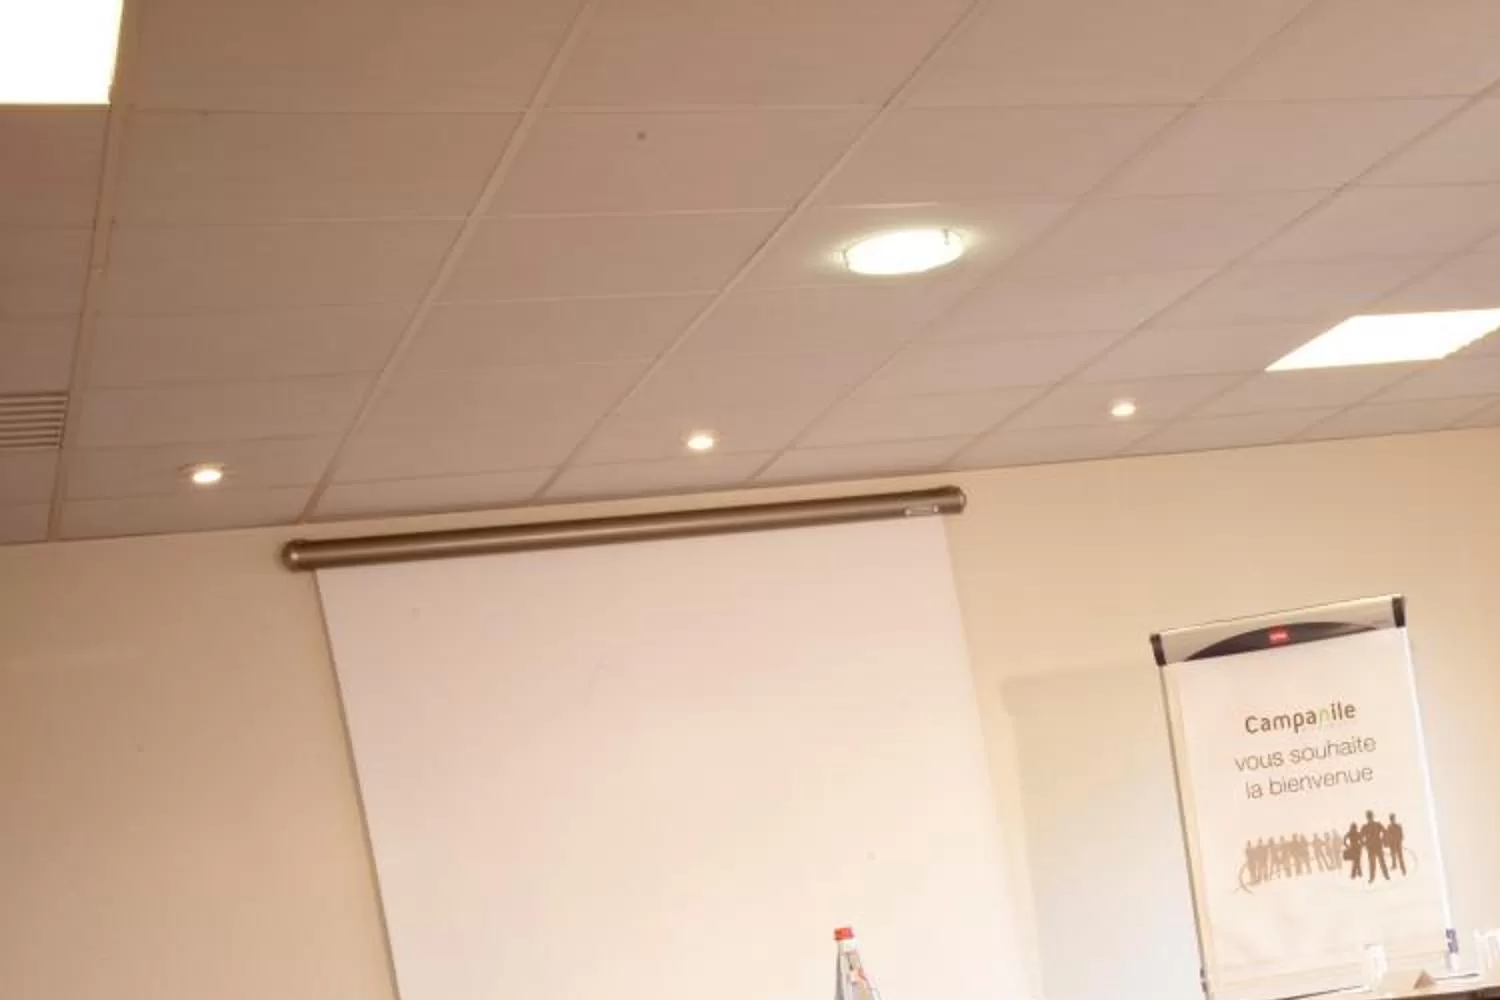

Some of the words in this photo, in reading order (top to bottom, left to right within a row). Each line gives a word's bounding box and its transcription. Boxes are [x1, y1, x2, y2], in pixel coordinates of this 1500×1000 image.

[1244, 700, 1356, 734] Campanile
[1234, 749, 1285, 773] vous
[1290, 735, 1377, 764] souhaite
[1245, 780, 1264, 800] la
[1268, 766, 1374, 797] bienvenue
